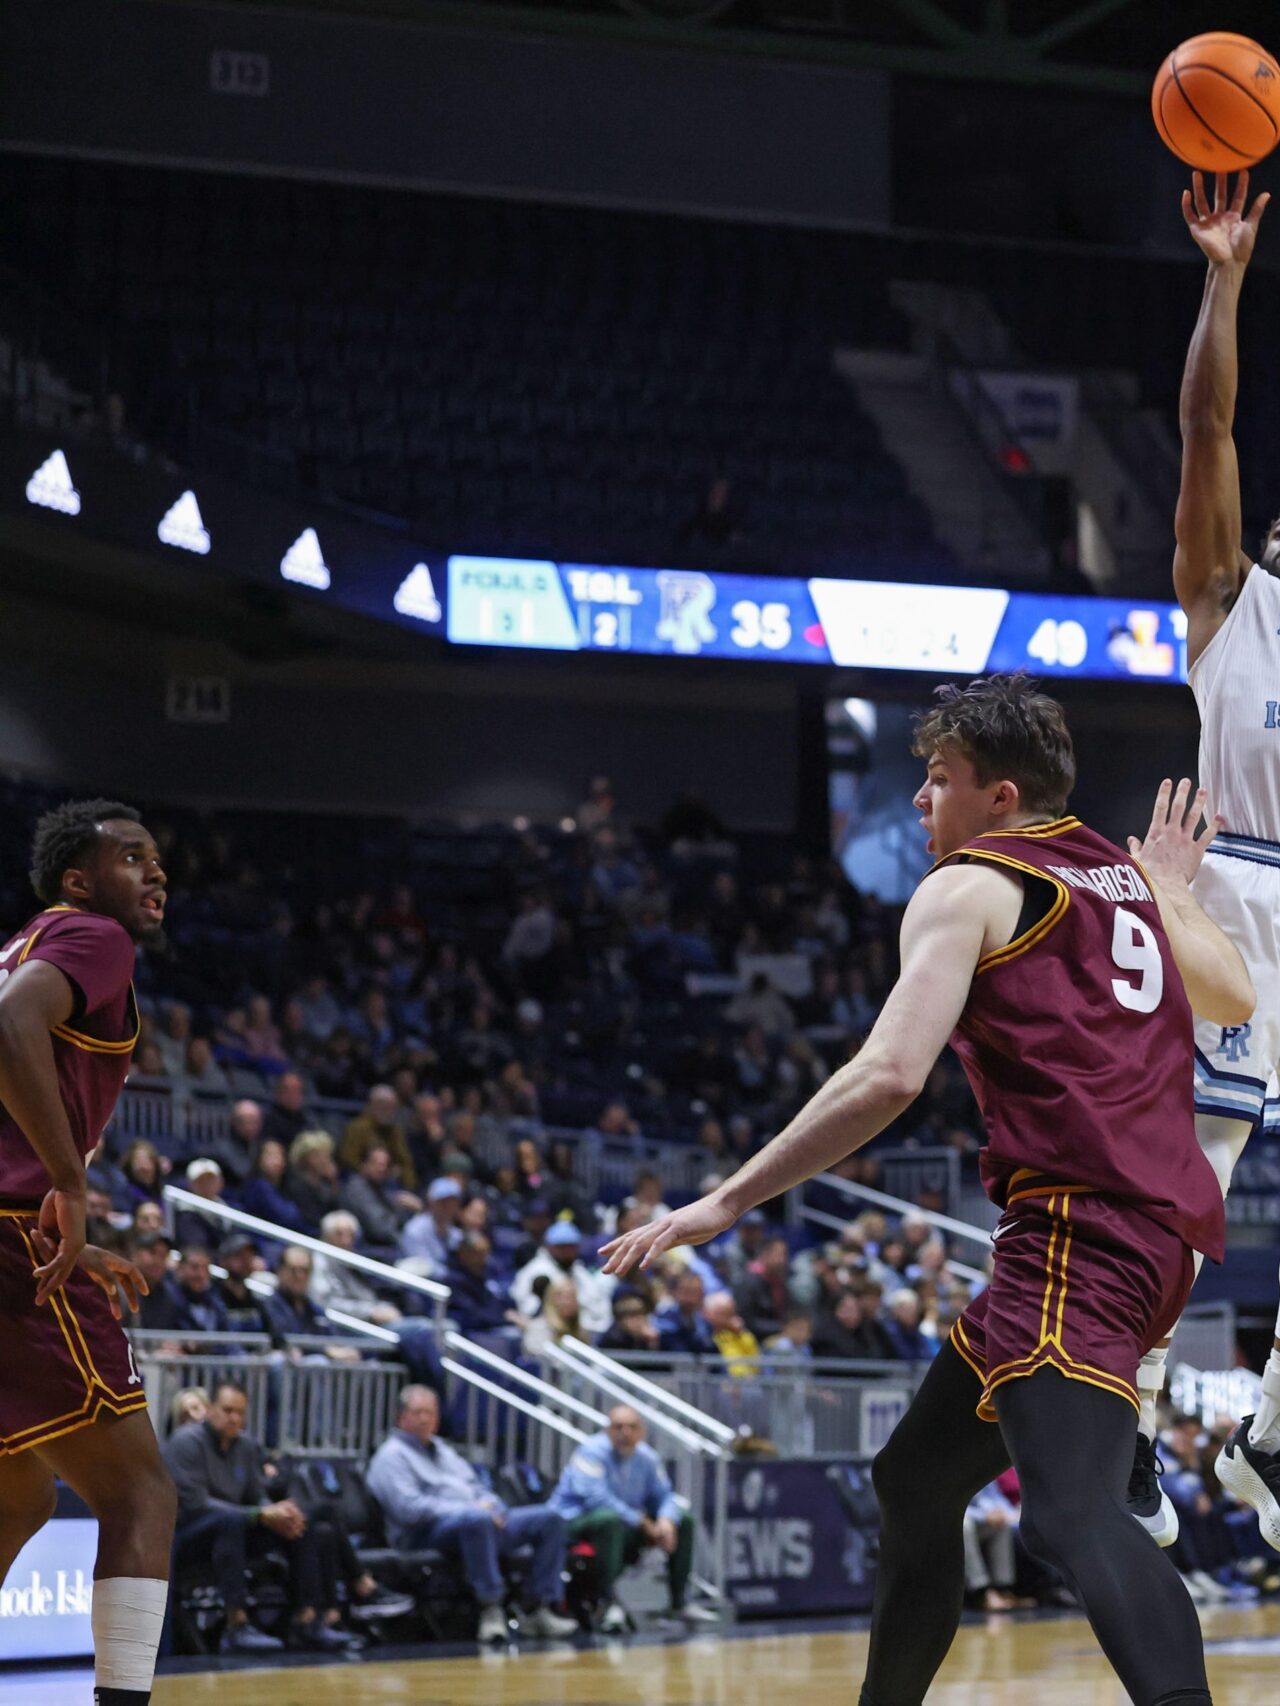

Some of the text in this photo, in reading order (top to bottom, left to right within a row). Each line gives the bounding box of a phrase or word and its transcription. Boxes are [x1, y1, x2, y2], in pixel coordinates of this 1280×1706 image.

[594, 612, 618, 647] 2
[730, 600, 792, 650] 35
[1028, 618, 1087, 668] 49
[1110, 905, 1165, 1015] 9
